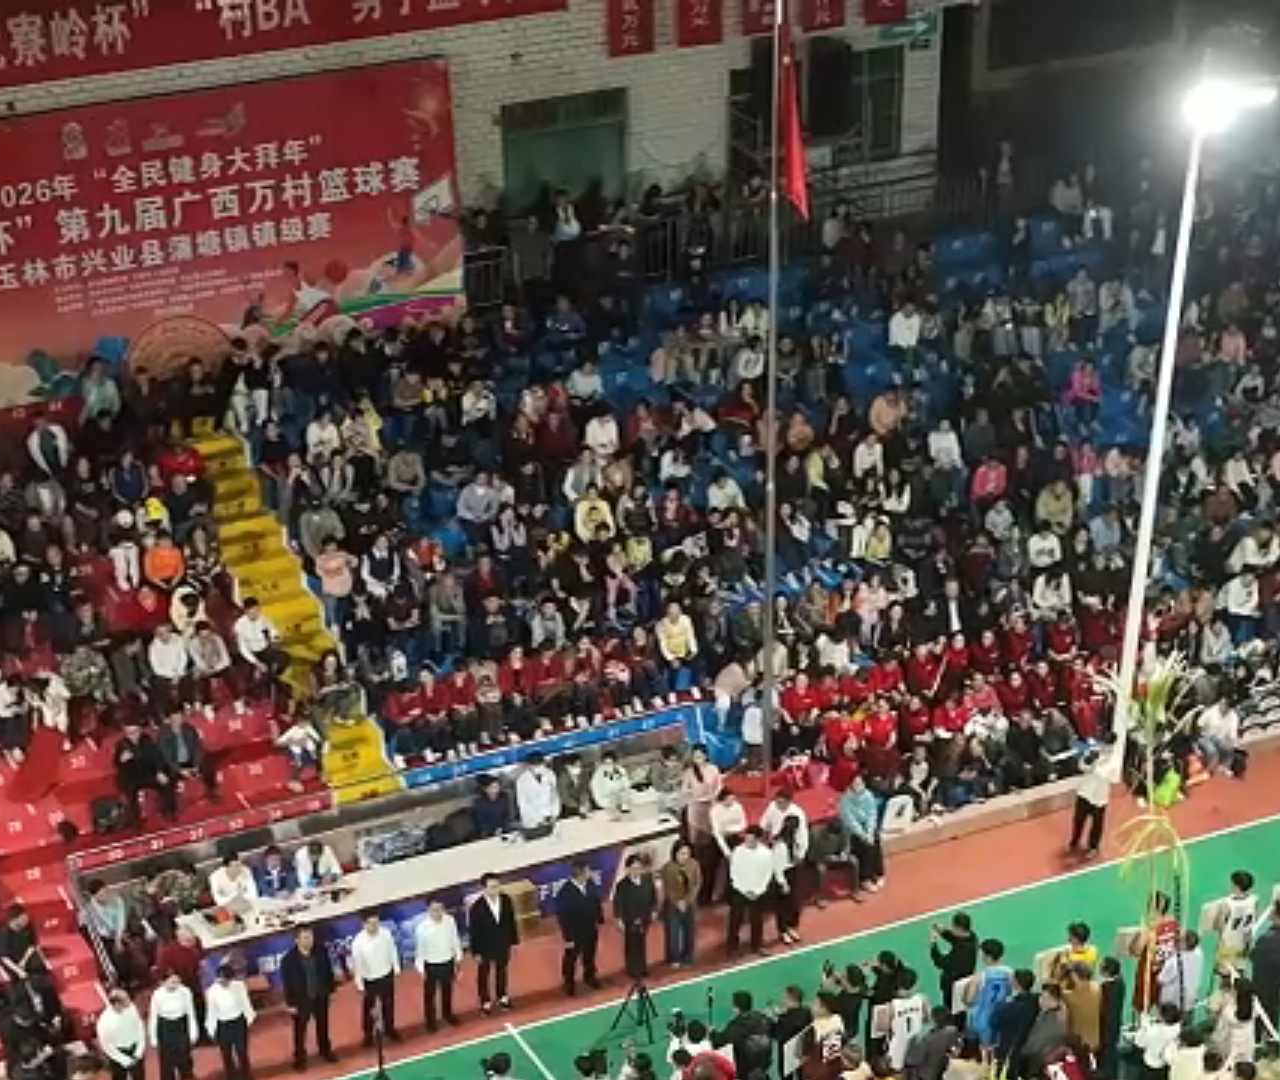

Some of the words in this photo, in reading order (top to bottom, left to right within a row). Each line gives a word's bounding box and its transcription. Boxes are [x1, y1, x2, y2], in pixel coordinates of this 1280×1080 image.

[56, 156, 421, 244] 第九届广西万村篮球赛
